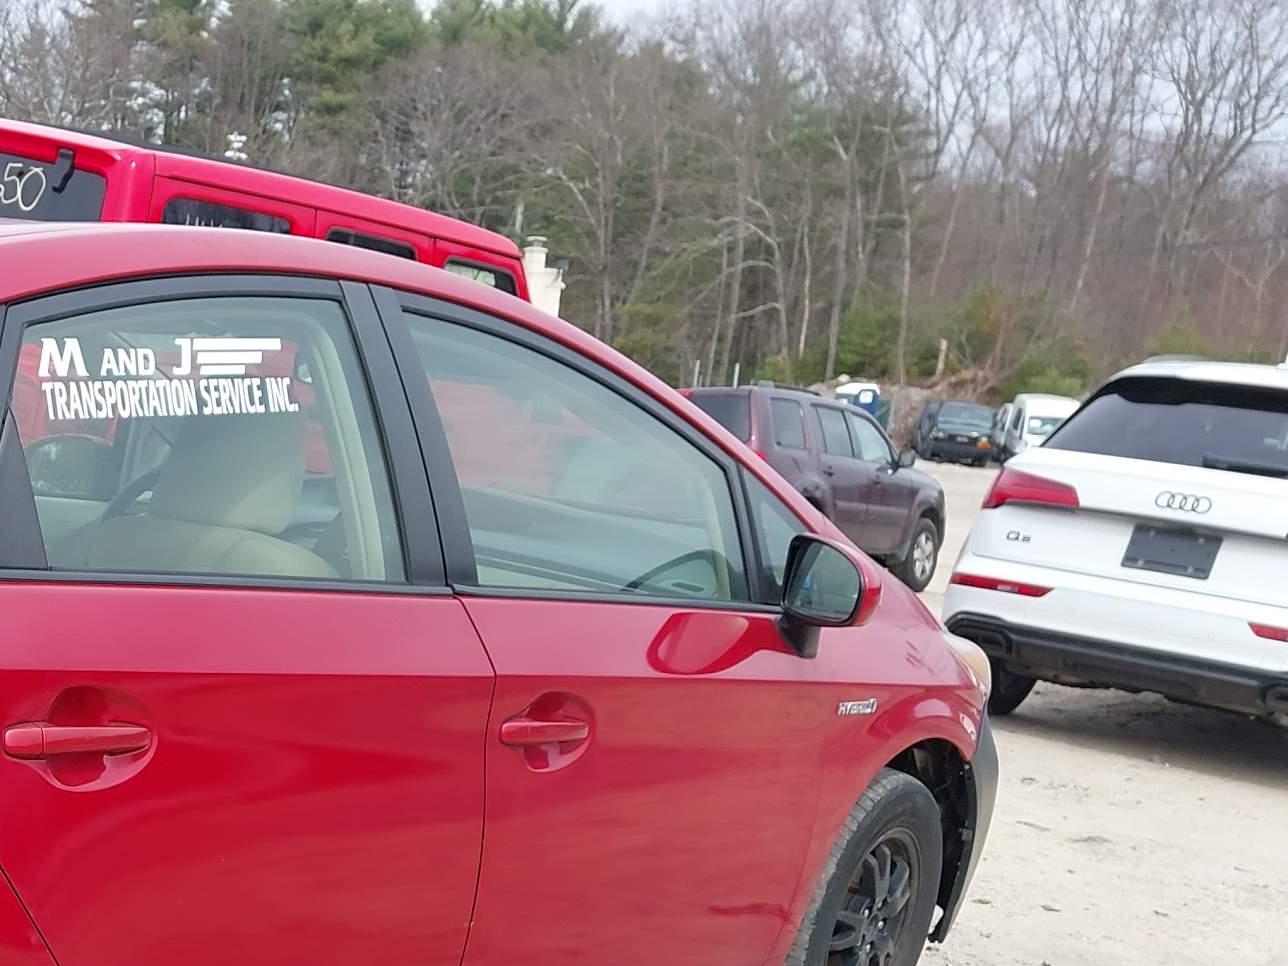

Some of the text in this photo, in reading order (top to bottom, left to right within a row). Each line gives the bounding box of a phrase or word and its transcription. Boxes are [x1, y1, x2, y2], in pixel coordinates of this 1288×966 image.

[38, 337, 90, 377] M
[100, 348, 156, 376] AND
[42, 376, 300, 420] TRANSPORTATION SERVICE INC.
